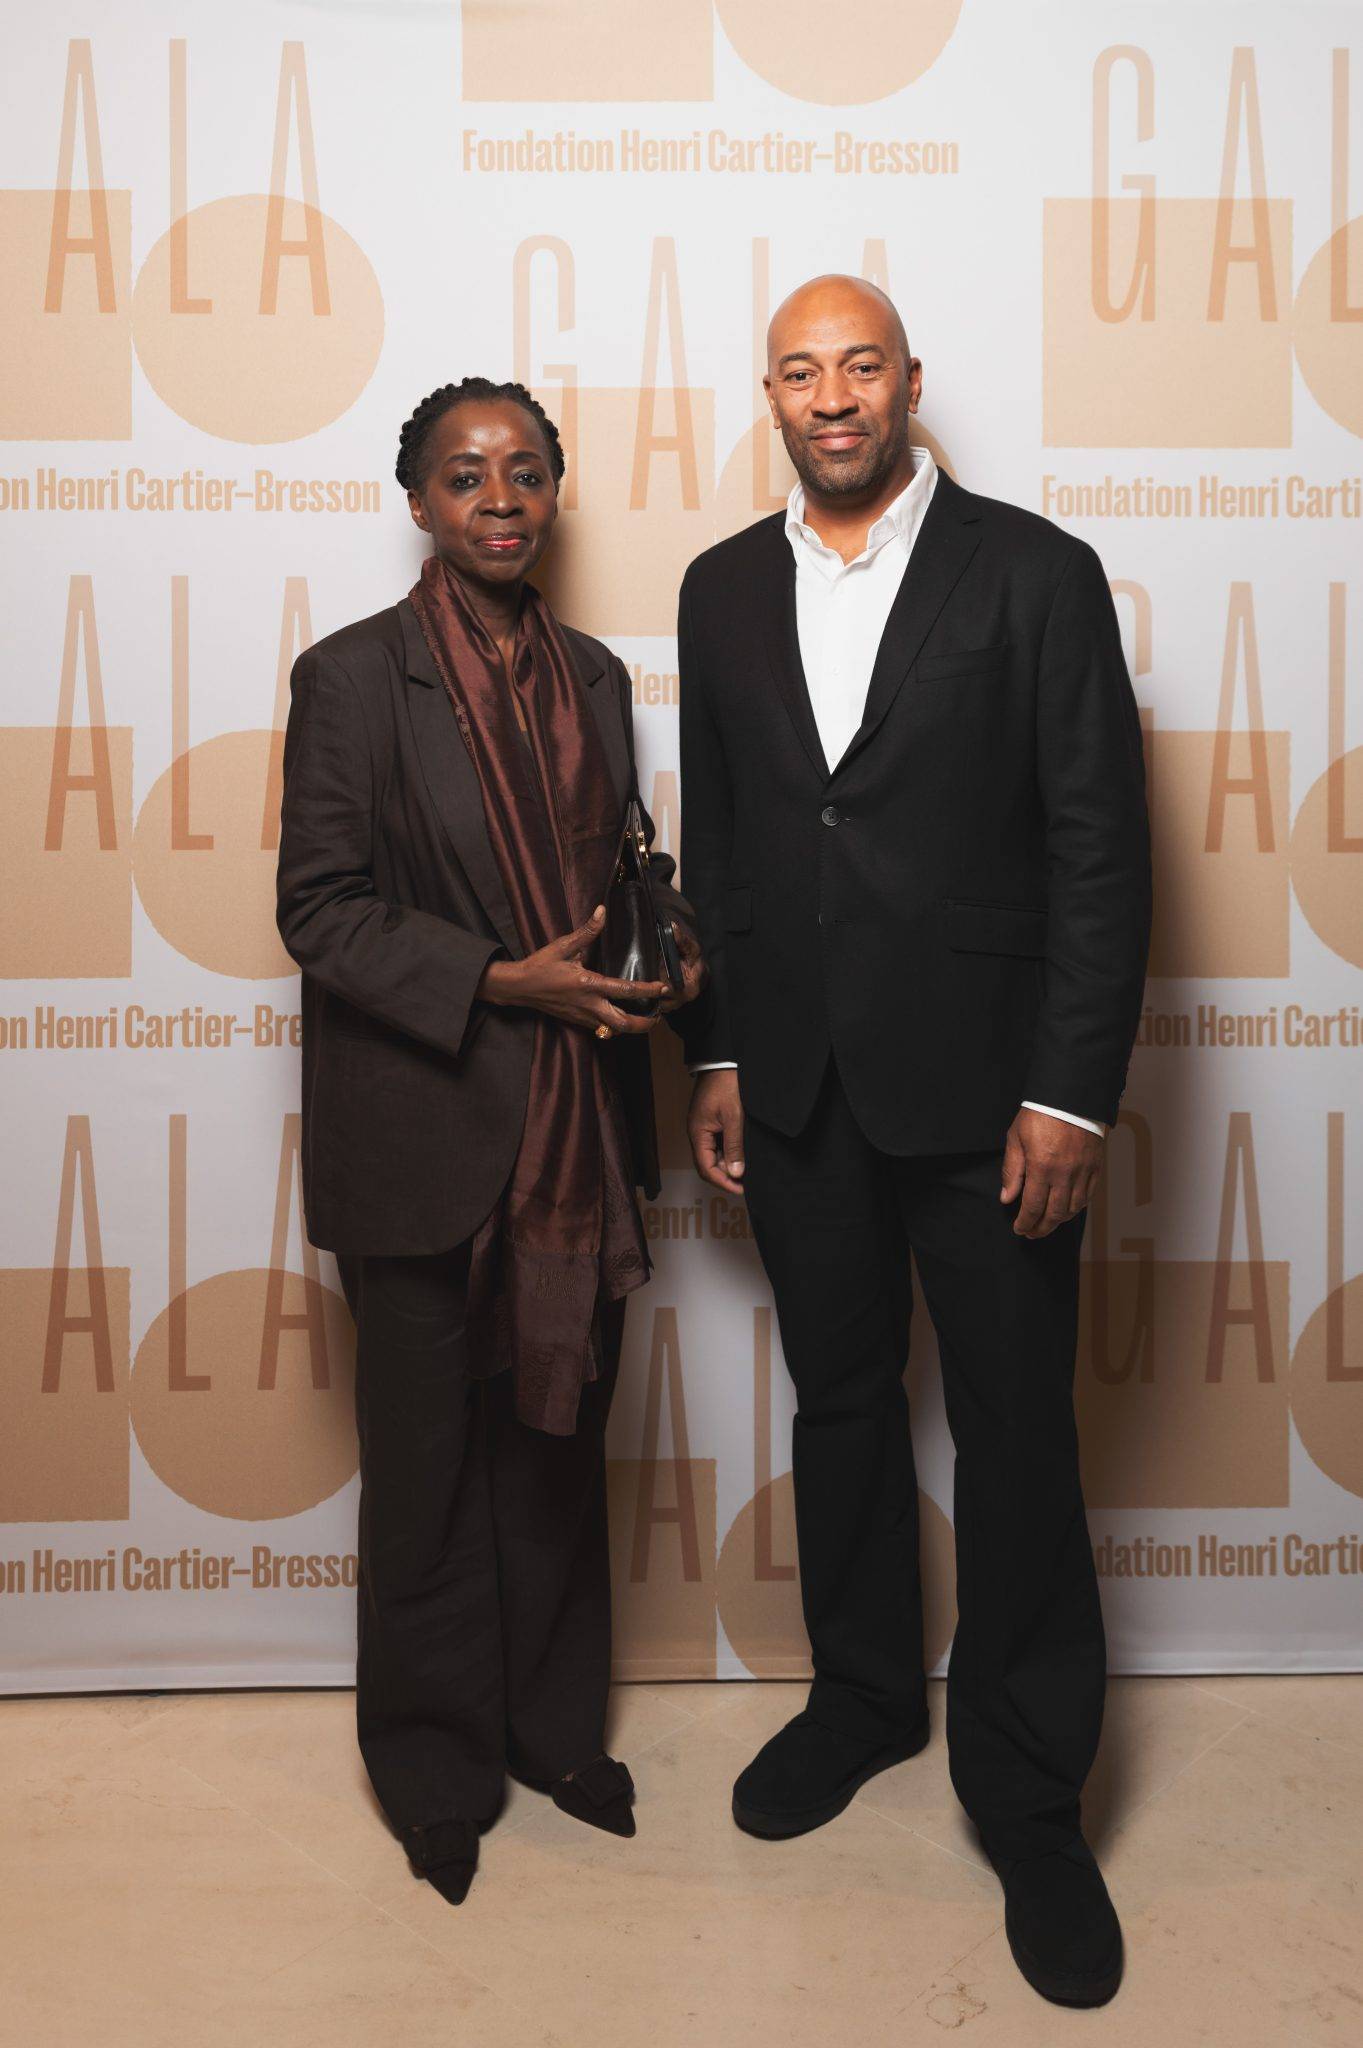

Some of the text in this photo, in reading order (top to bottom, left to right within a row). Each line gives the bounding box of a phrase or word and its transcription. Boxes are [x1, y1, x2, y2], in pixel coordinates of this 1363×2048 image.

[463, 129, 959, 174] Fondation Henri Cartier-Bresson
[37, 468, 118, 511] Henri
[126, 468, 381, 513] Cartier-Bresson
[1042, 475, 1191, 517] Fondation
[1199, 475, 1279, 517] Henri
[35, 1006, 117, 1049] Henri
[1198, 1005, 1277, 1047] Henri
[1283, 1004, 1363, 1047] Carti
[33, 1549, 115, 1593] Henri
[1199, 1535, 1277, 1577] Henri
